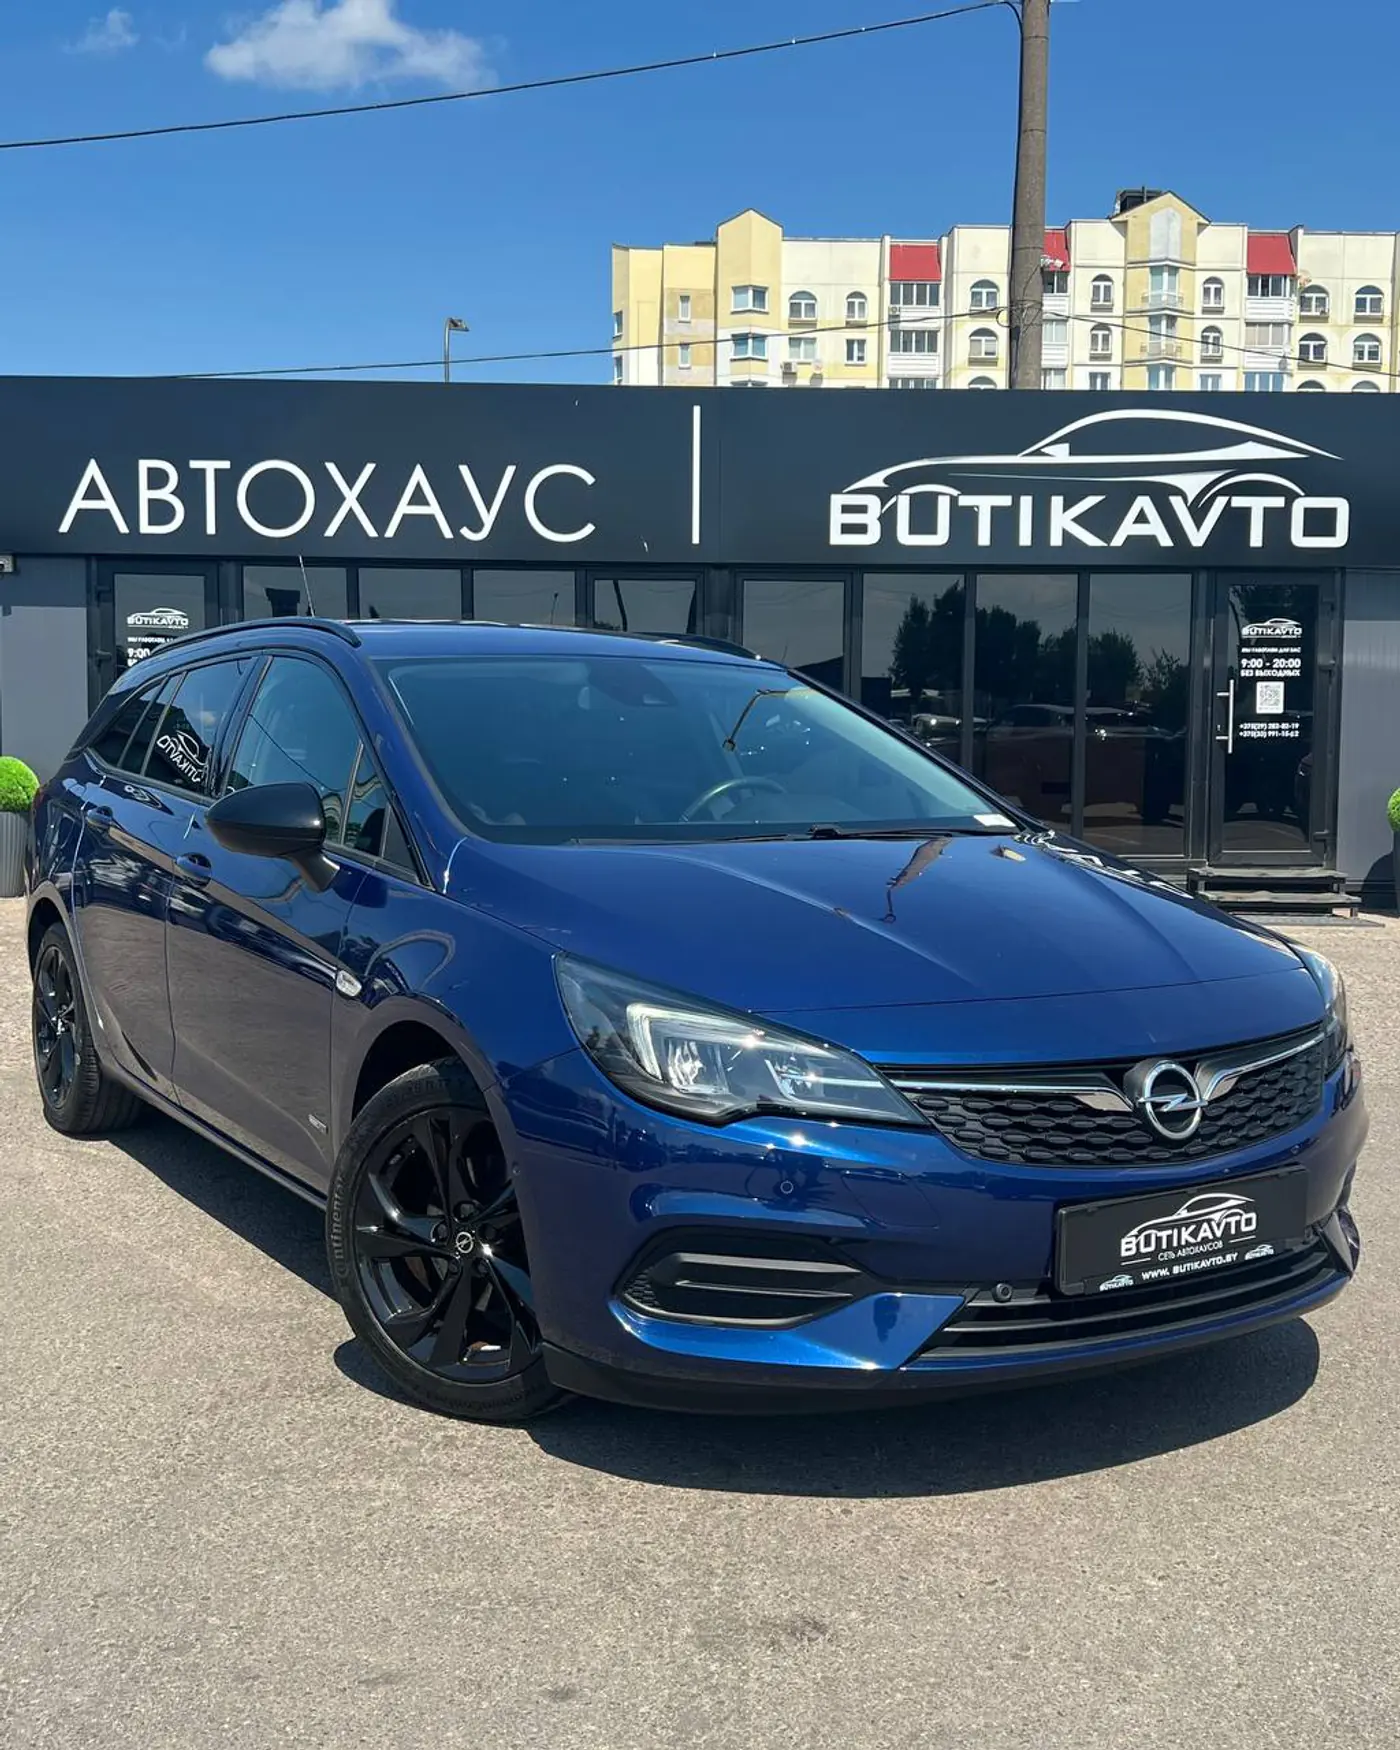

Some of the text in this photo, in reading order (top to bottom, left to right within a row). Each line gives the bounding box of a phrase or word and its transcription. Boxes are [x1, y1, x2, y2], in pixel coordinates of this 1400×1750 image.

[58, 458, 597, 543] АВТОХАУС
[828, 493, 1351, 549] BUTIKAVTO
[127, 616, 189, 626] BUTIKAVTO
[1241, 626, 1303, 636] BUTIKAVTO
[1241, 658, 1263, 668] 9:00
[1272, 658, 1301, 668] 20:00
[1240, 669, 1301, 677] БЕЗ ВЫХОДНЫХ
[1121, 1212, 1257, 1257] BUTIKAVTO
